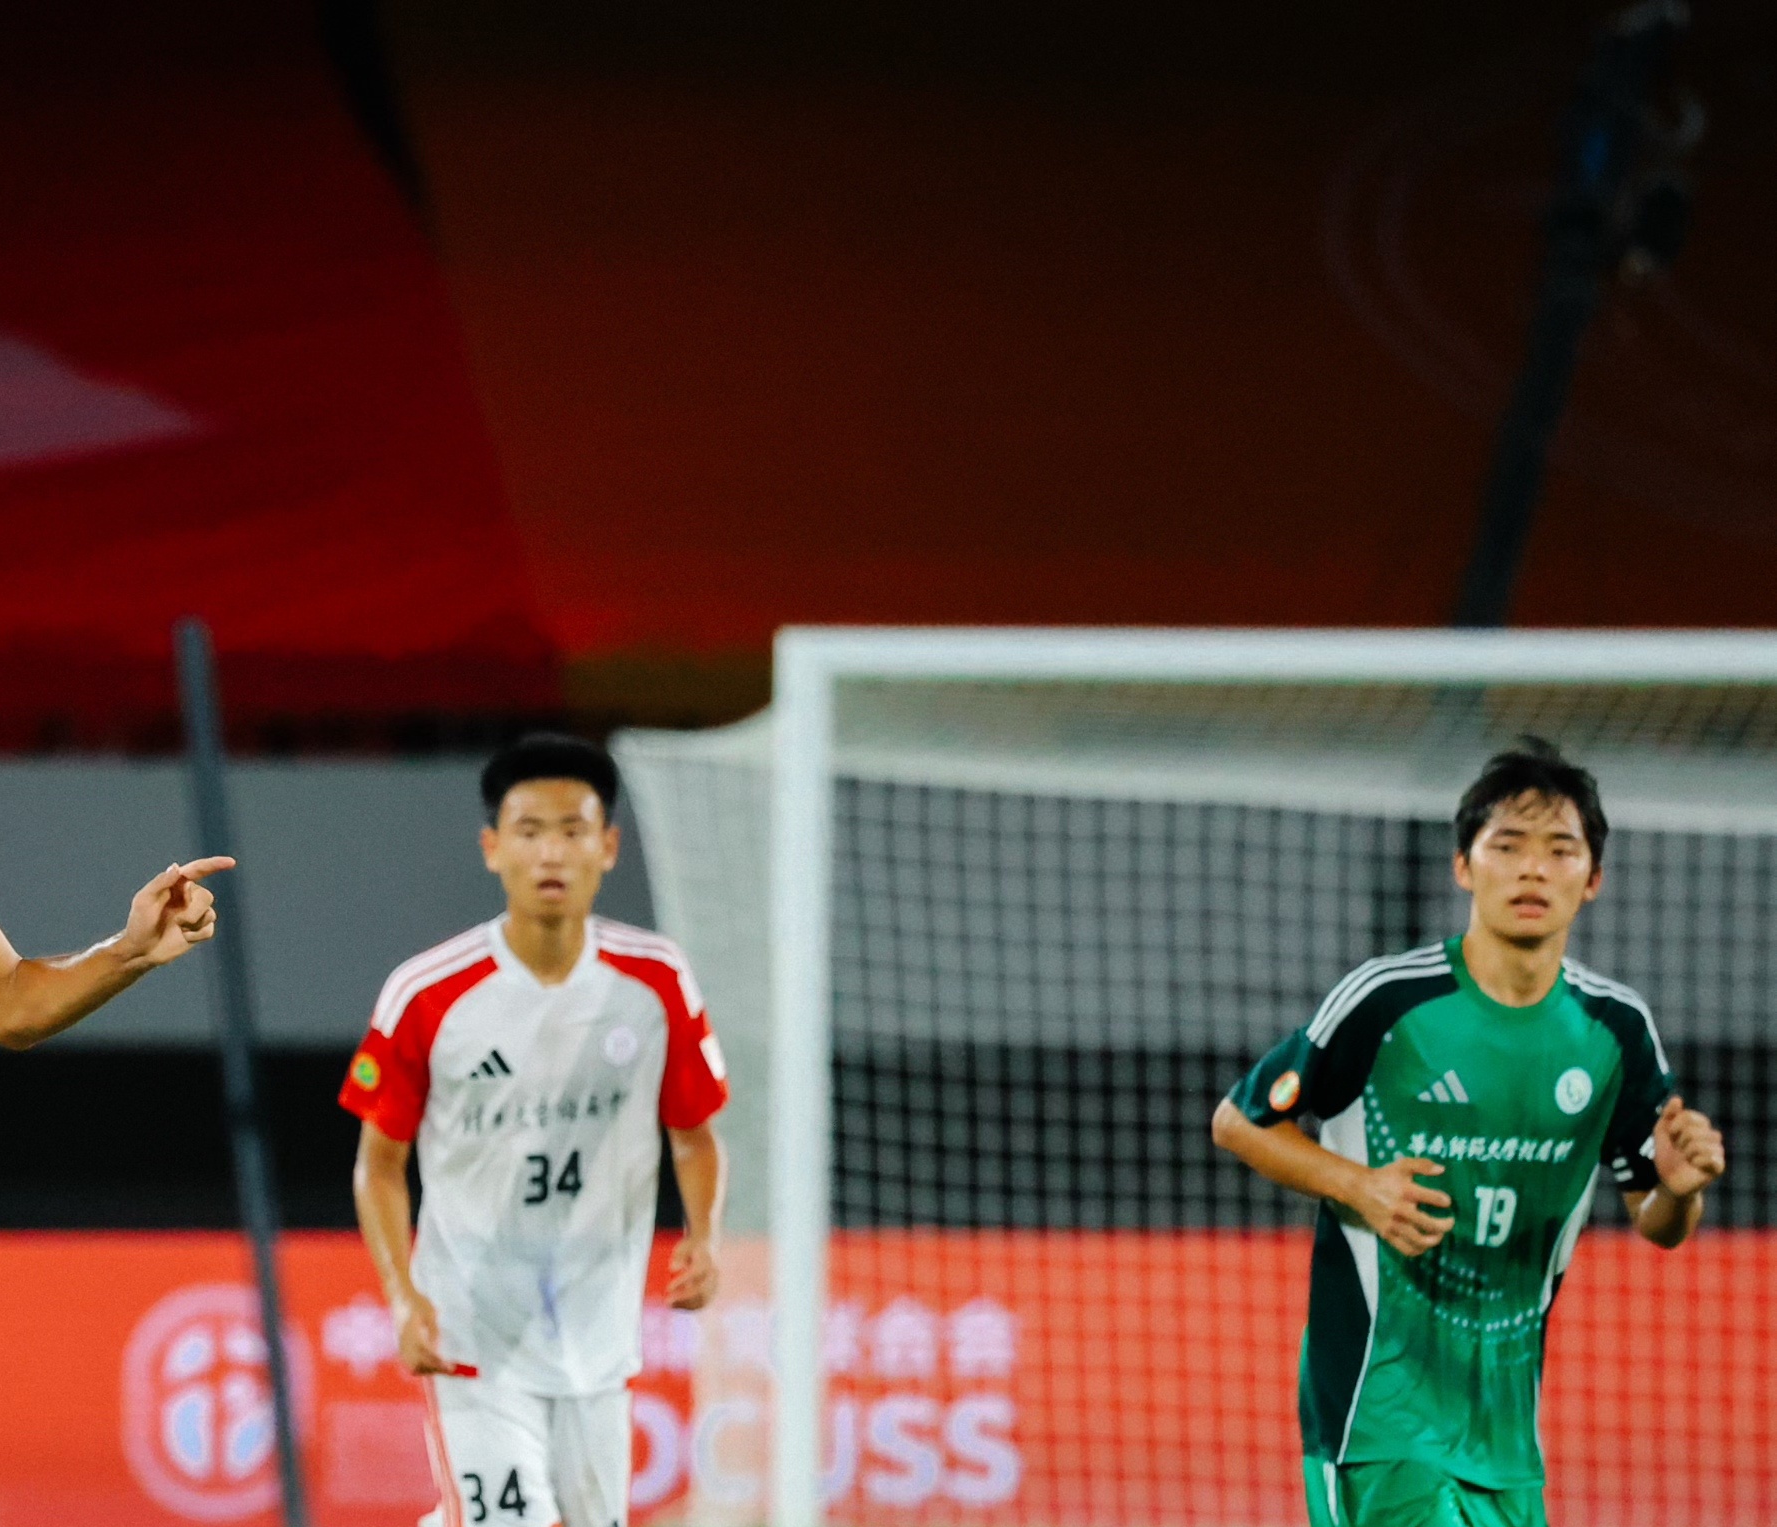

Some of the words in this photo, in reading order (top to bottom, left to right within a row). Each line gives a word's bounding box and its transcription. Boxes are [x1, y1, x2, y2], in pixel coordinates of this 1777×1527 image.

[524, 1150, 582, 1204] 34
[1475, 1186, 1517, 1247] 19
[463, 1468, 526, 1522] 34
